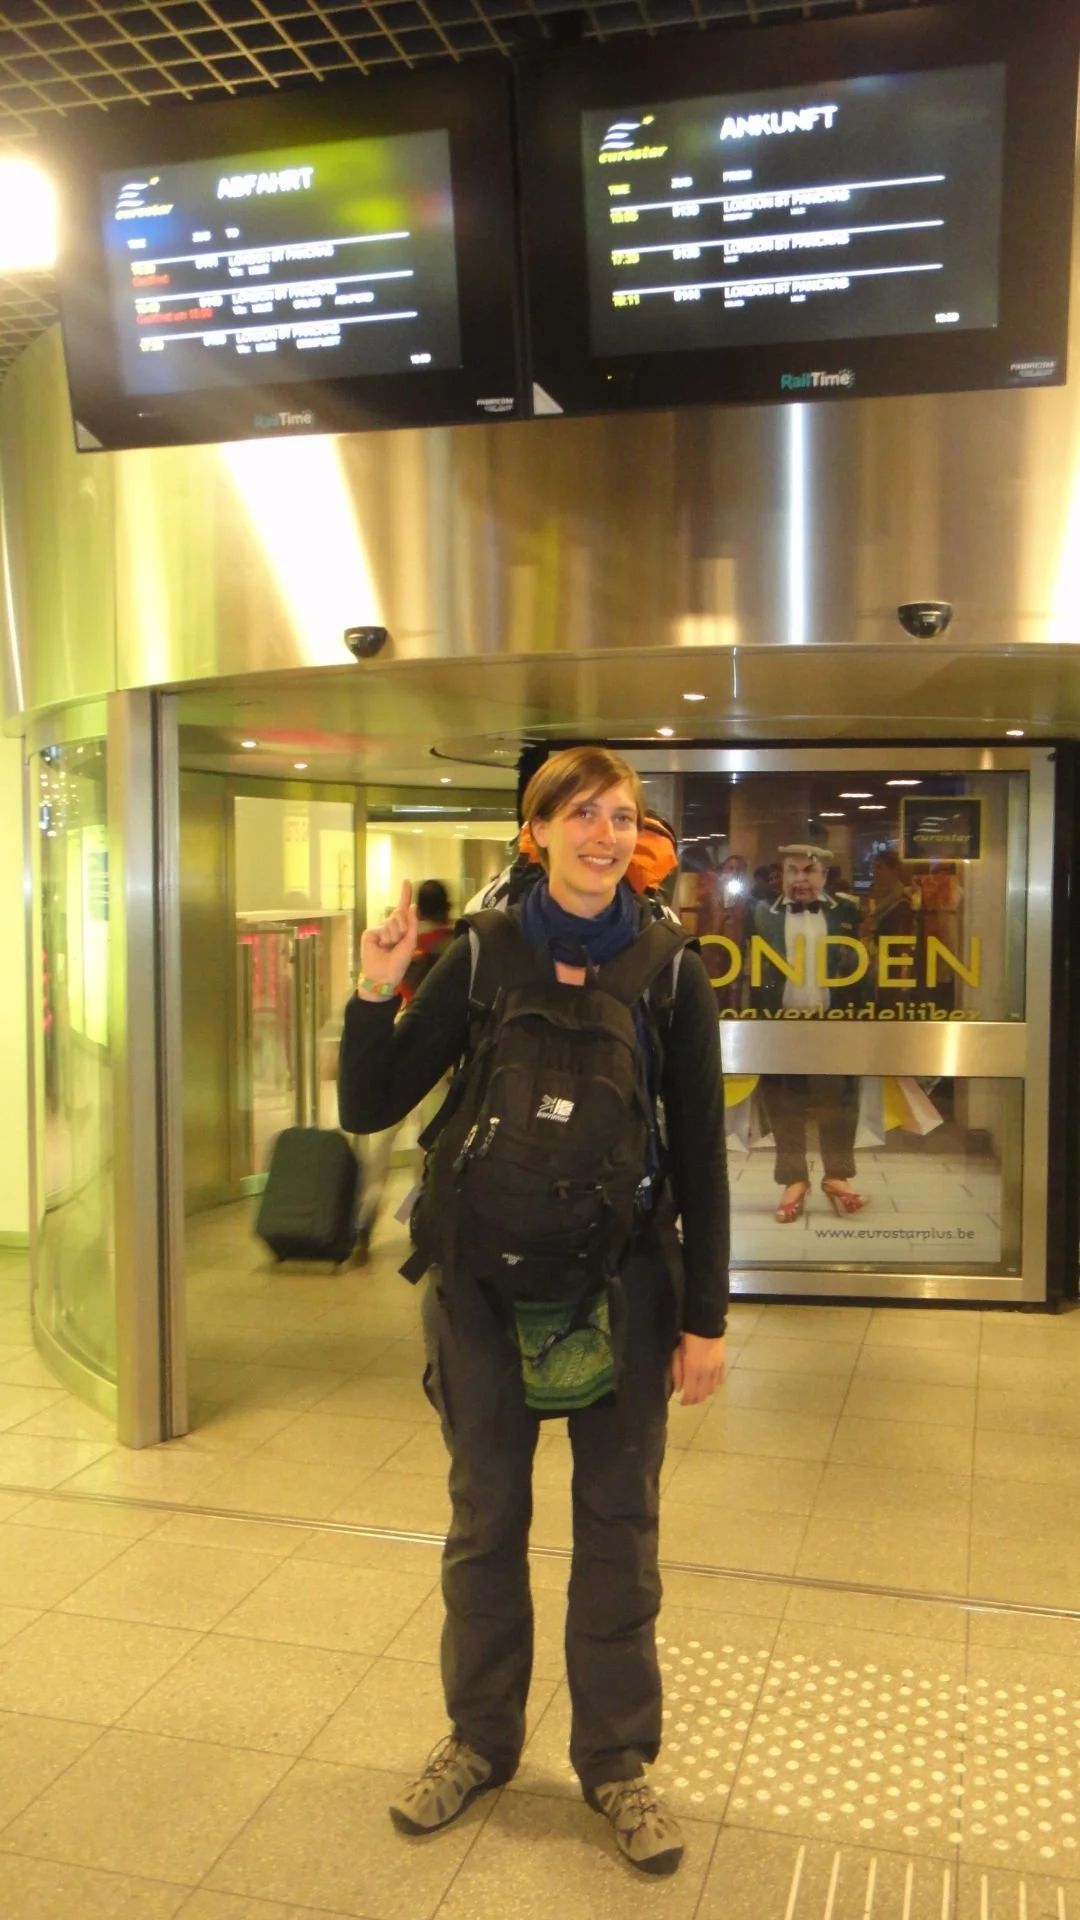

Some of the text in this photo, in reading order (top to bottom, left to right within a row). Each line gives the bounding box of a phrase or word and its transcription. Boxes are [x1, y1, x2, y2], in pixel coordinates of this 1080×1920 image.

[719, 104, 839, 140] ANKUNFT
[598, 146, 668, 164] eurostar
[217, 167, 314, 199] ABFAHRT
[780, 371, 852, 390] RailTime
[699, 935, 982, 988] ONDEN
[815, 1227, 975, 1241] www.eurostarplus.be
